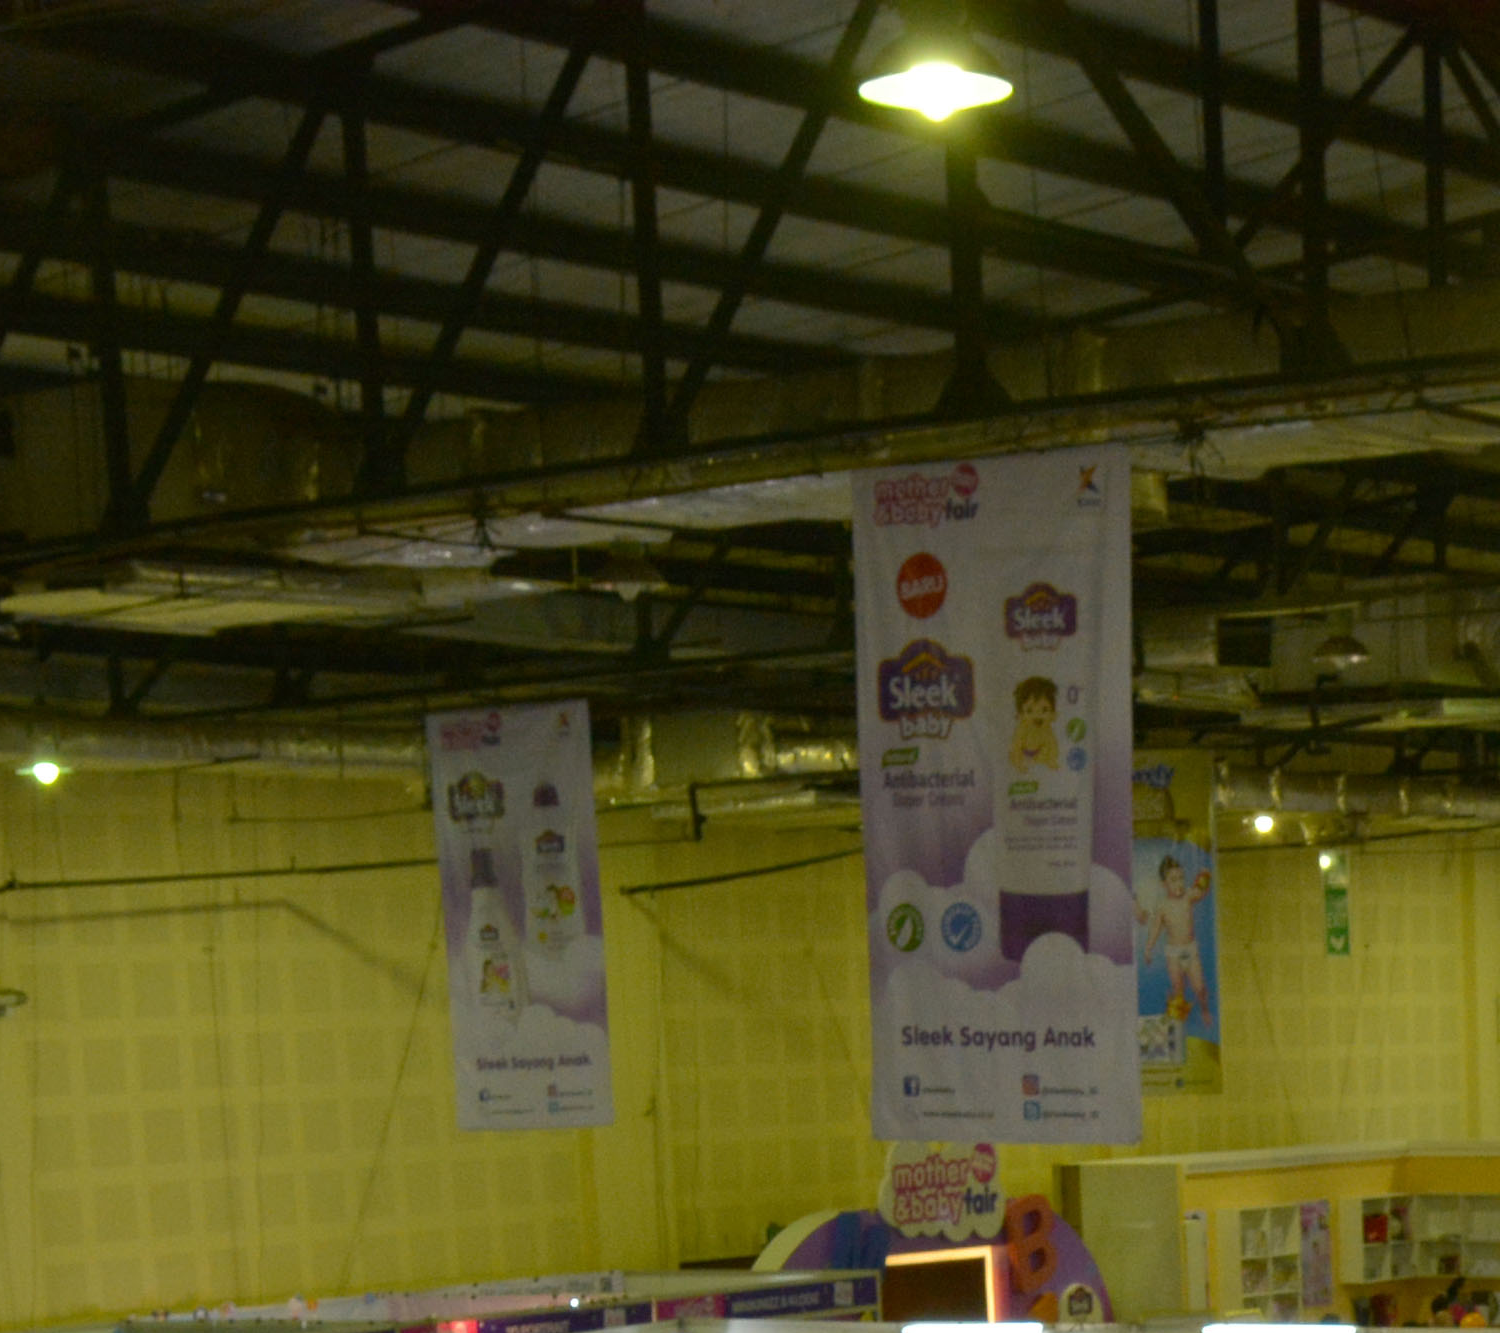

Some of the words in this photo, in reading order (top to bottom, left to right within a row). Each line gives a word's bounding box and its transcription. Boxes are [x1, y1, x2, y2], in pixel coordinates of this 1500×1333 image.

[1014, 606, 1067, 630] Sleek
[888, 674, 957, 708] Sleek
[902, 716, 950, 738] baby
[884, 769, 975, 789] Antibacterial
[902, 1027, 953, 1047] Sleek
[960, 1027, 1036, 1051] Sayang
[1044, 1026, 1095, 1048] Anak
[893, 1153, 970, 1188] mother
[964, 1186, 999, 1214] fair
